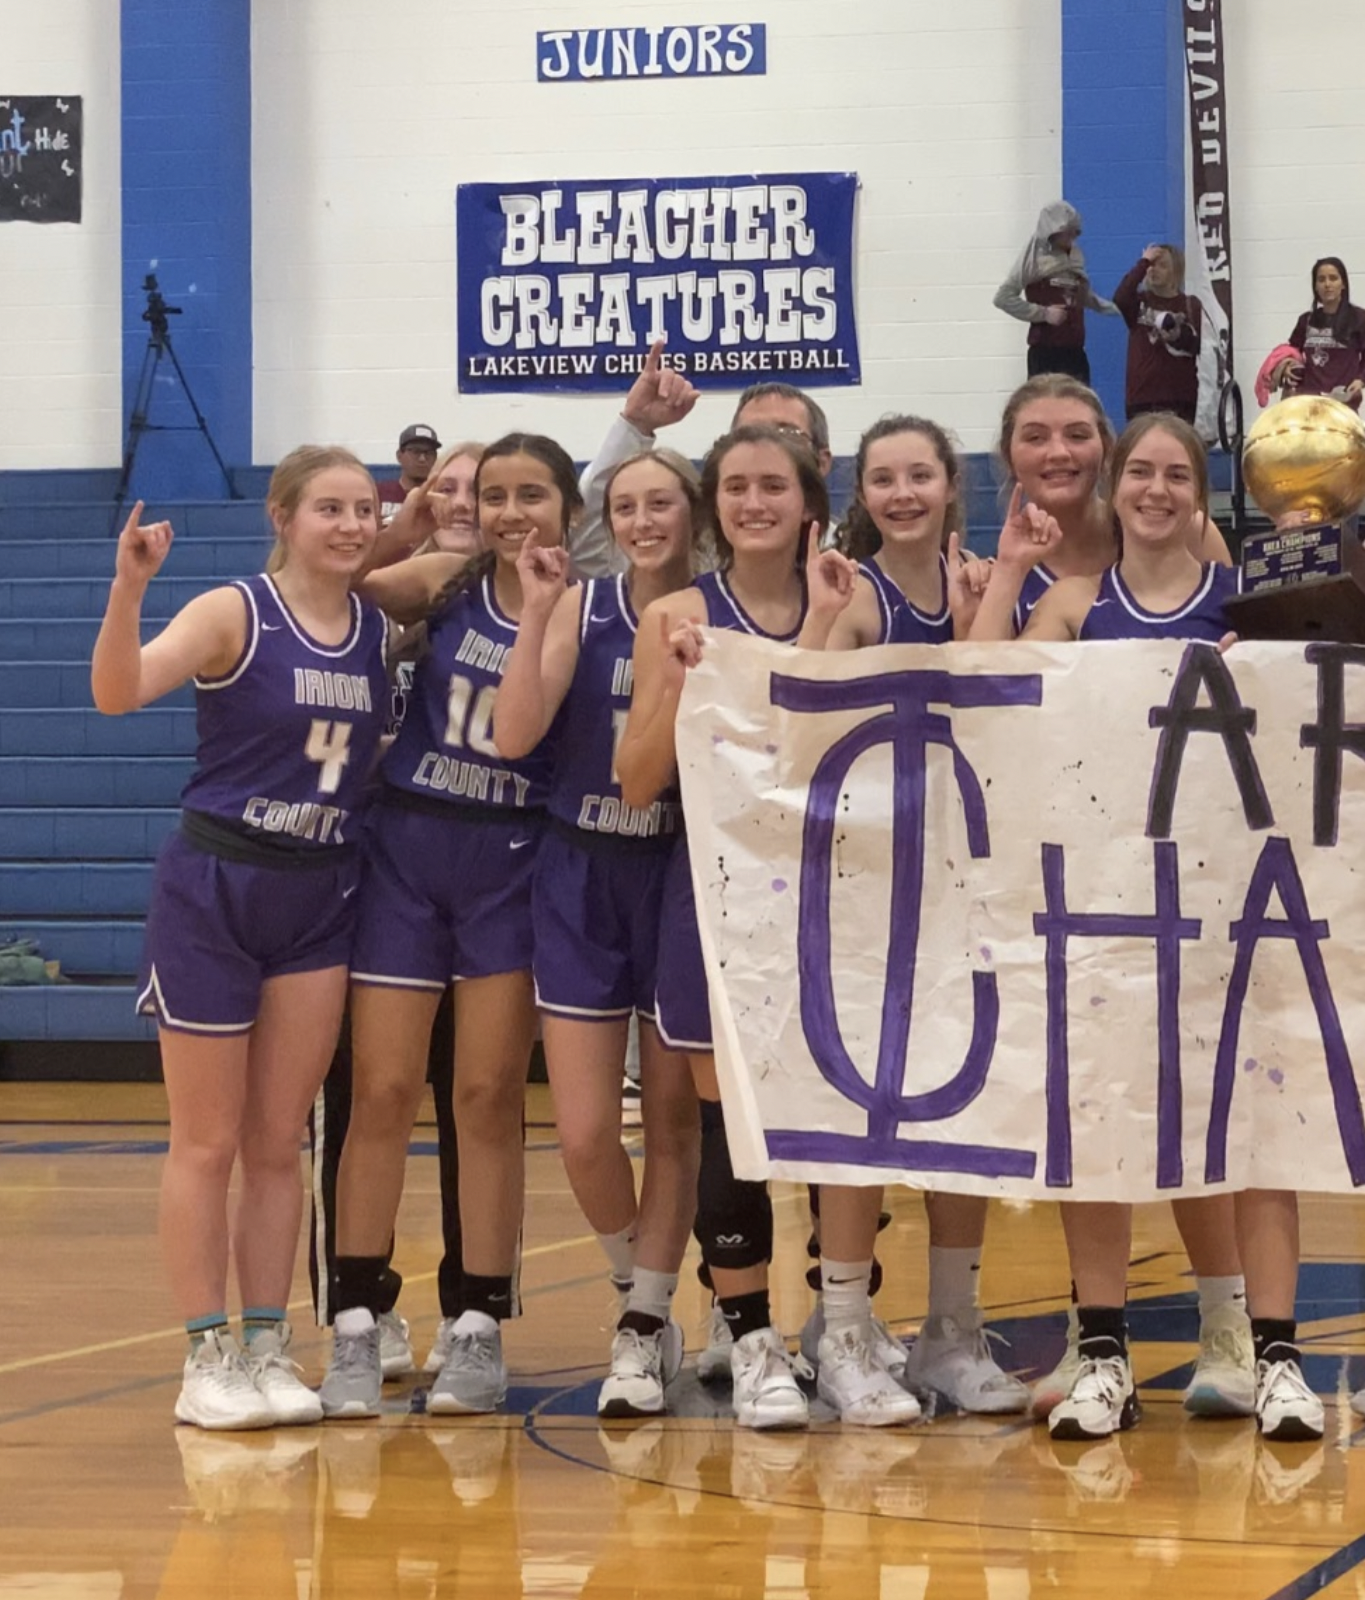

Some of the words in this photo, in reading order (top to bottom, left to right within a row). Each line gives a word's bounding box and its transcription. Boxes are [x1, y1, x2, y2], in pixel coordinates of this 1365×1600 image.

[542, 24, 754, 78] JUNIORS
[499, 185, 814, 266] BLEACHER
[481, 267, 837, 349] CREATURES
[469, 355, 597, 377] LAKEVIEW
[605, 353, 687, 374] CHIFS
[694, 349, 849, 373] BASKETBALL
[294, 667, 372, 713] IRION
[304, 718, 353, 794] 4
[412, 751, 530, 807] COUNTY
[577, 794, 684, 838] COUNT
